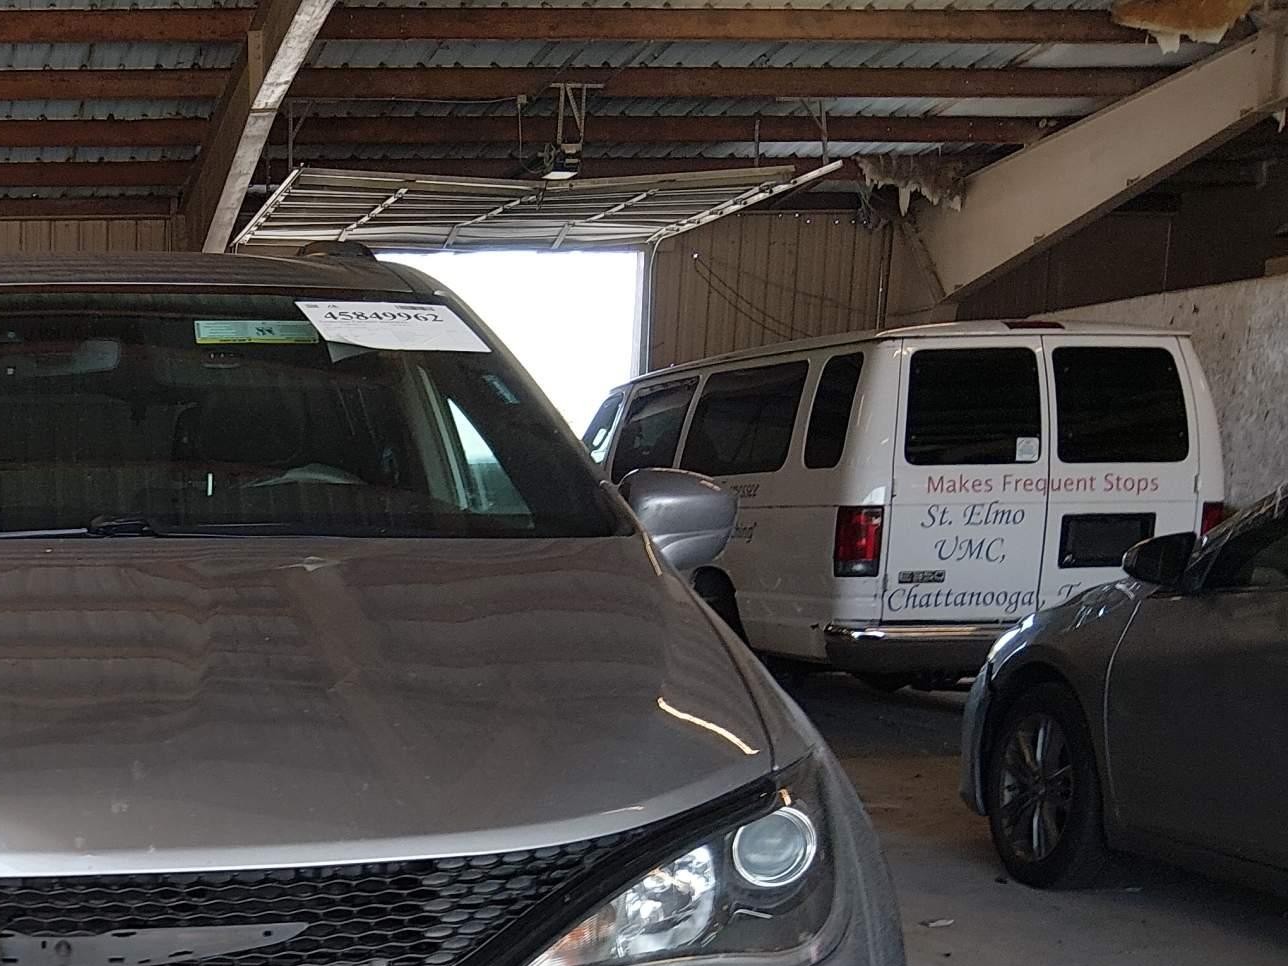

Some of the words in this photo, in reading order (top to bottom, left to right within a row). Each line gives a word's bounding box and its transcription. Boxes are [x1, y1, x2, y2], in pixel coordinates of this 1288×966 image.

[323, 310, 444, 323] 45849962
[927, 475, 993, 493] Makes
[1002, 473, 1096, 496] Frequent
[1103, 473, 1159, 495] Stops
[920, 504, 953, 528] St.
[962, 500, 1025, 526] Elmo
[934, 536, 1006, 563] UMC,
